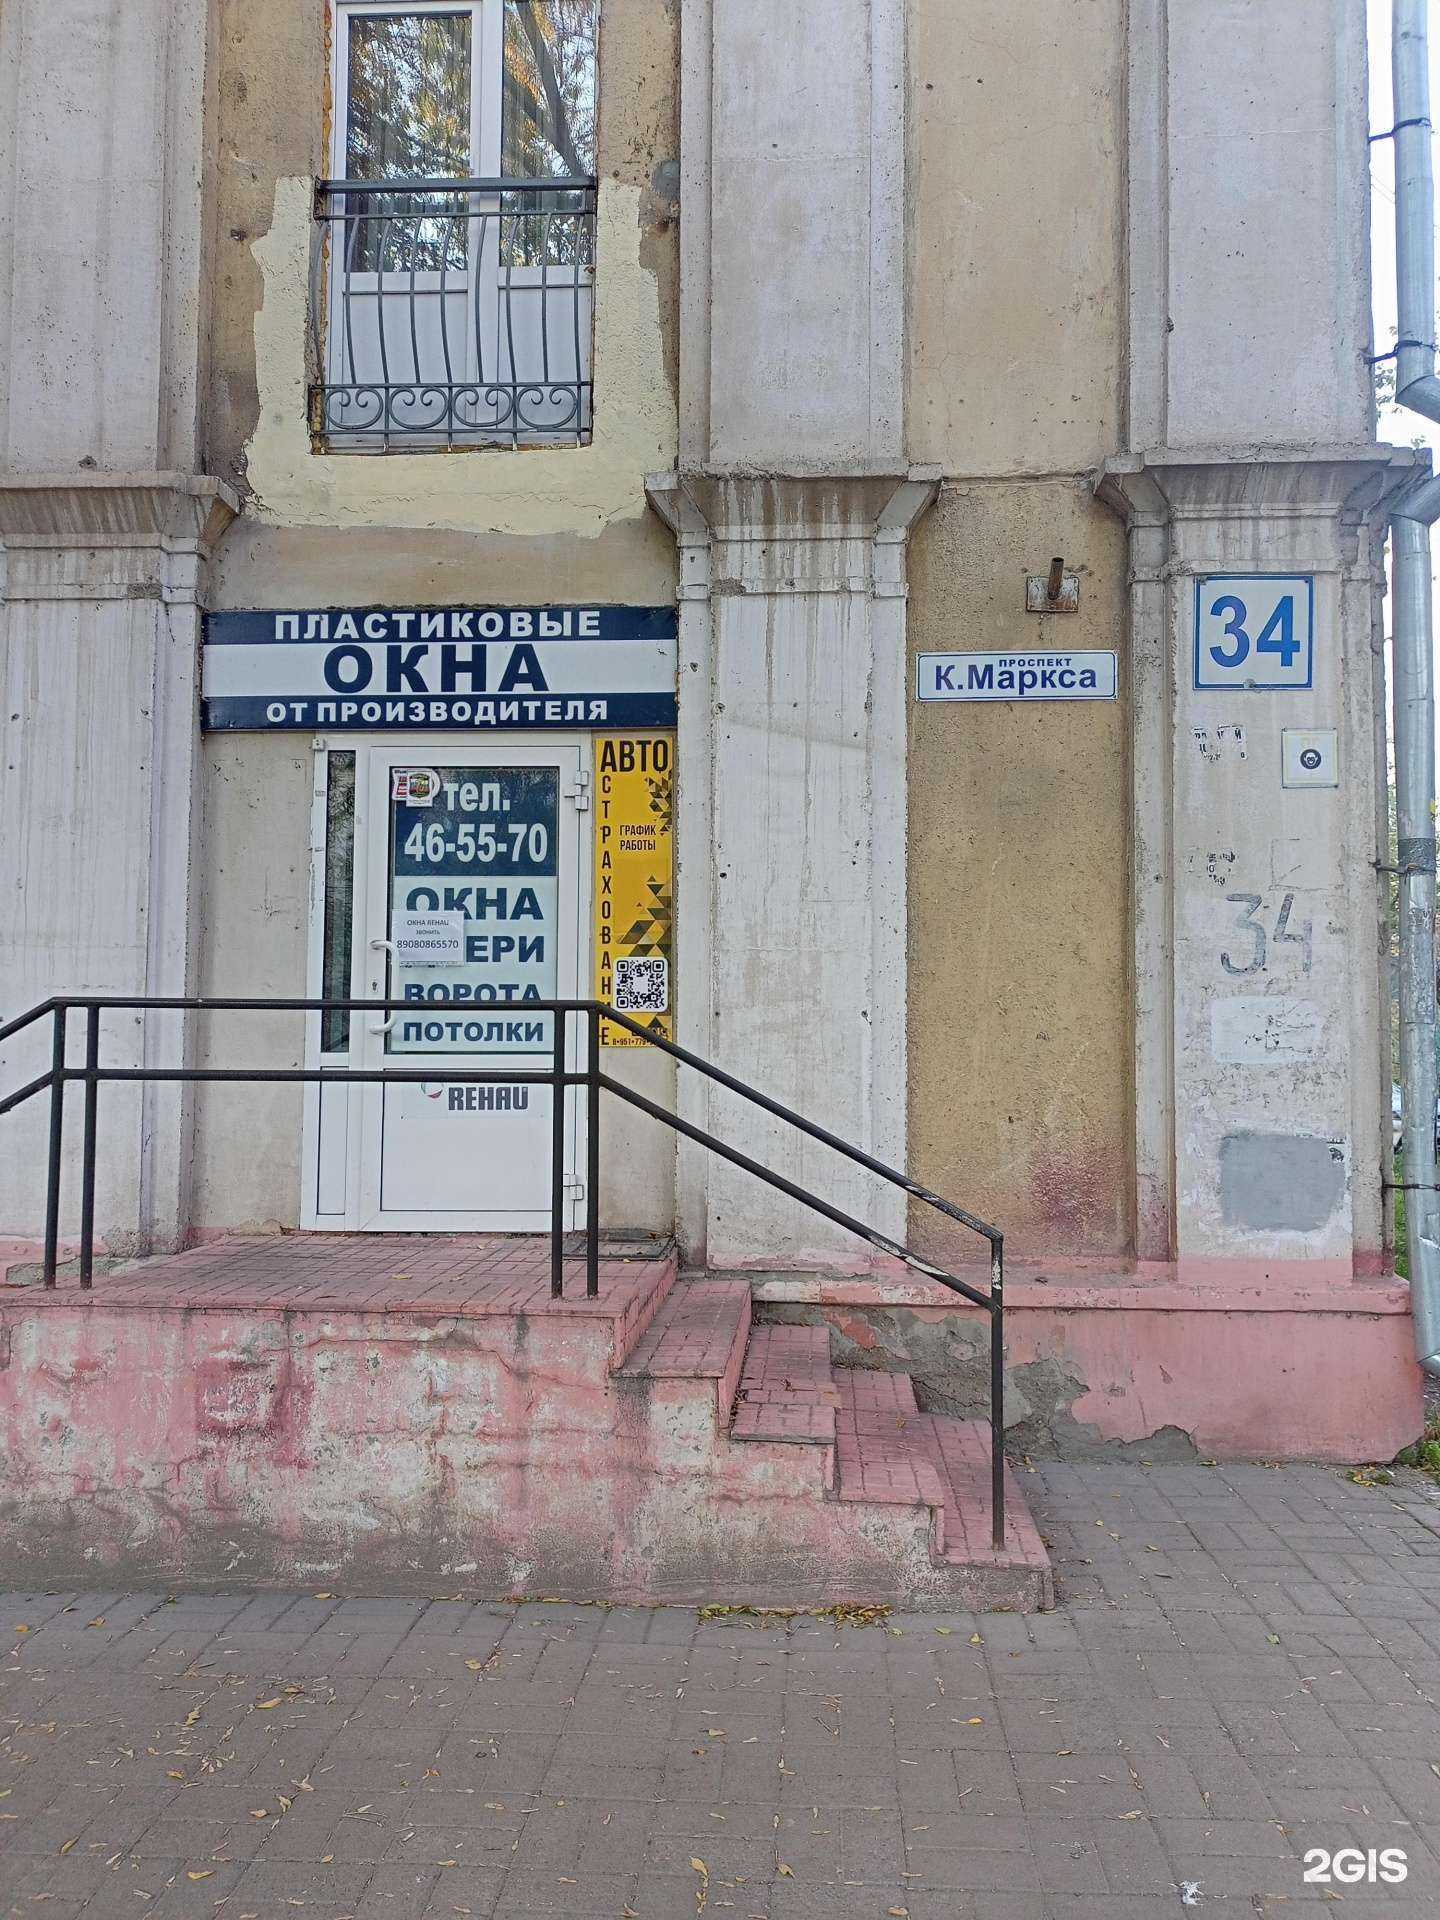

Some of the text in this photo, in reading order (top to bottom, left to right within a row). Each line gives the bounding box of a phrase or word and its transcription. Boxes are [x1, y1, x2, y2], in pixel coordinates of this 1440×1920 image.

[274, 611, 601, 639] ПЛАСТИКОВЫЕ
[1209, 594, 1301, 669] 34
[323, 642, 550, 694] ОКНА
[999, 658, 1072, 667] ПРОСПЕКТ
[935, 664, 1097, 695] К.Маркса
[266, 700, 608, 725] ОТ ПРОИЗВОДИТЕЛЯ
[600, 739, 668, 773] АВТО
[443, 782, 511, 813] тел.
[404, 823, 548, 862] 46-55-70
[619, 825, 657, 836] ГРАФИК
[619, 840, 656, 851] РАБОТЫ
[406, 887, 544, 920] ОКНА
[466, 935, 545, 962] ЕРИ
[1220, 892, 1314, 976] 34
[403, 1022, 544, 1042] ПОТОЛКИ
[448, 1086, 529, 1111] REHAU
